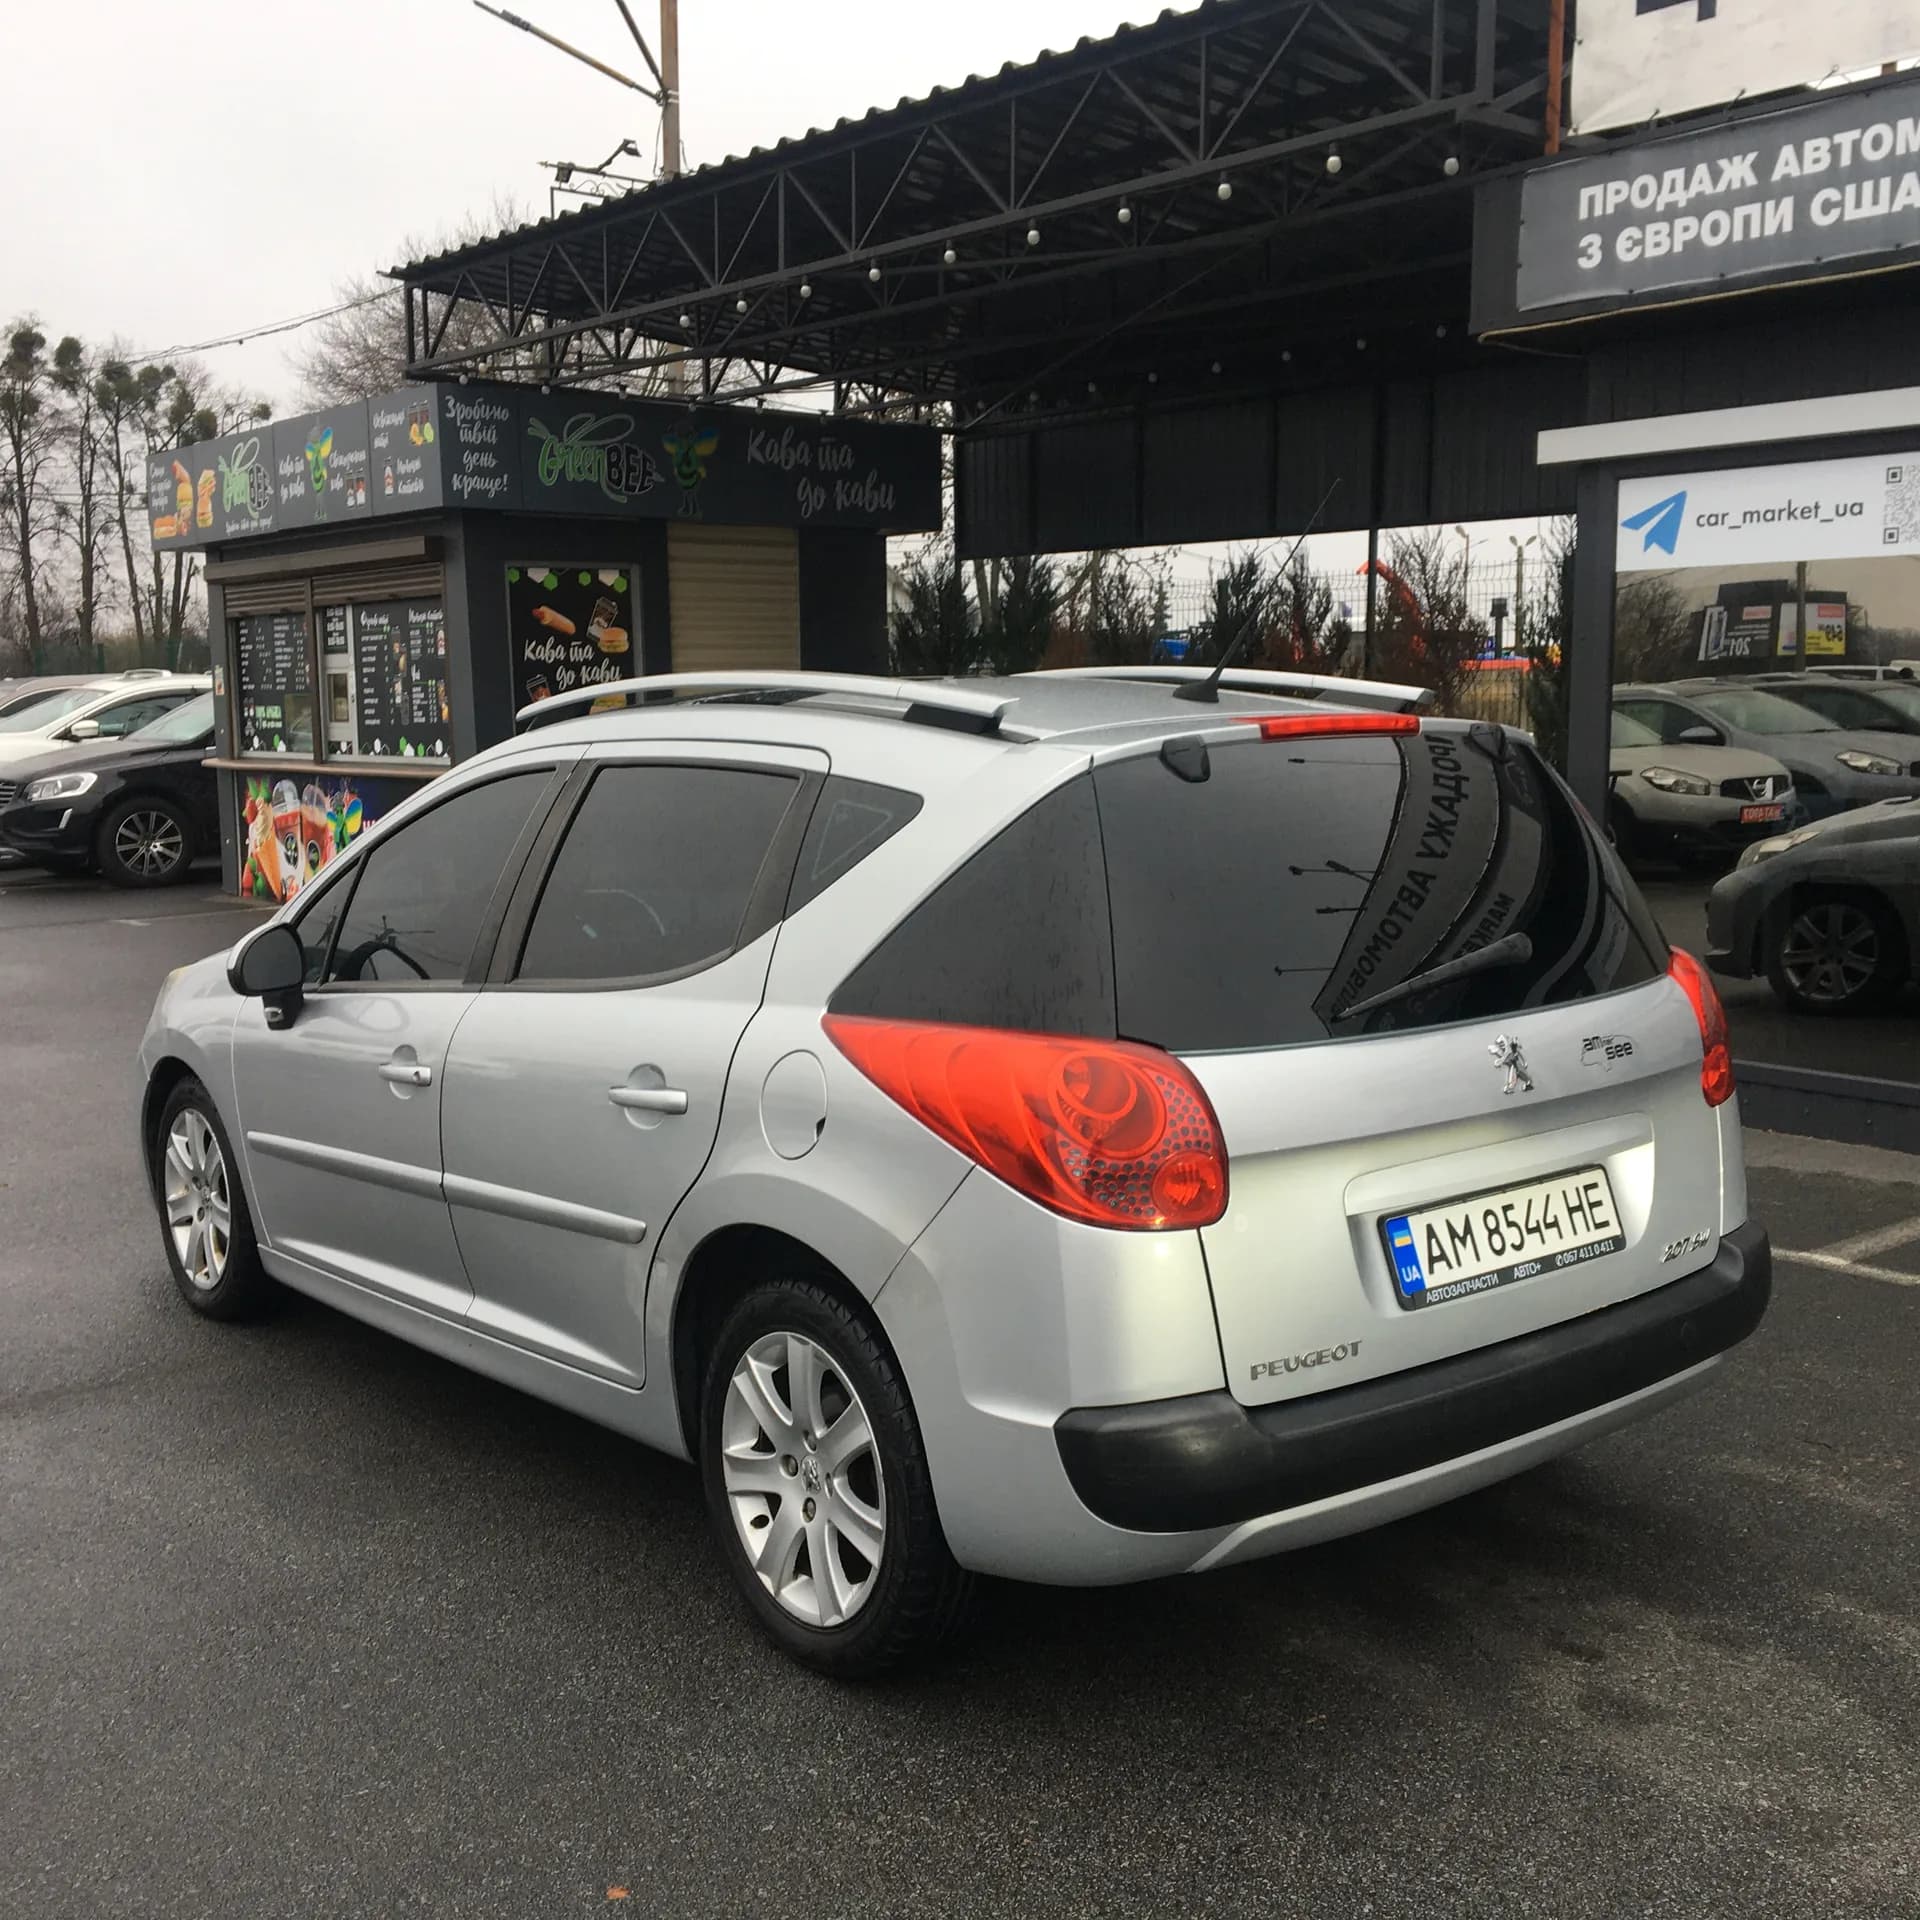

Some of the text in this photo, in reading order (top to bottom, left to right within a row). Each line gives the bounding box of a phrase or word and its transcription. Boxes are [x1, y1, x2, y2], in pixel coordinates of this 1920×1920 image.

[1578, 151, 1758, 220] ПРОДАЖ
[1577, 170, 1920, 270] З ЄВРОПИ США
[445, 395, 510, 427] Зробимо
[459, 423, 498, 445] твій
[747, 425, 855, 471] Кава та
[462, 449, 498, 473] день
[604, 443, 657, 495] BEE
[452, 473, 509, 499] краще!
[797, 468, 897, 518] до кави
[1696, 499, 1864, 530] car_market_ua
[524, 636, 595, 664] Кава та
[555, 658, 622, 691] до кави
[1483, 1193, 1563, 1256] 8544
[1401, 1265, 1422, 1283] UA
[1426, 1272, 1499, 1304] АВТОЗАПЧАСТИ
[1250, 1340, 1362, 1381] PEUGEOT
